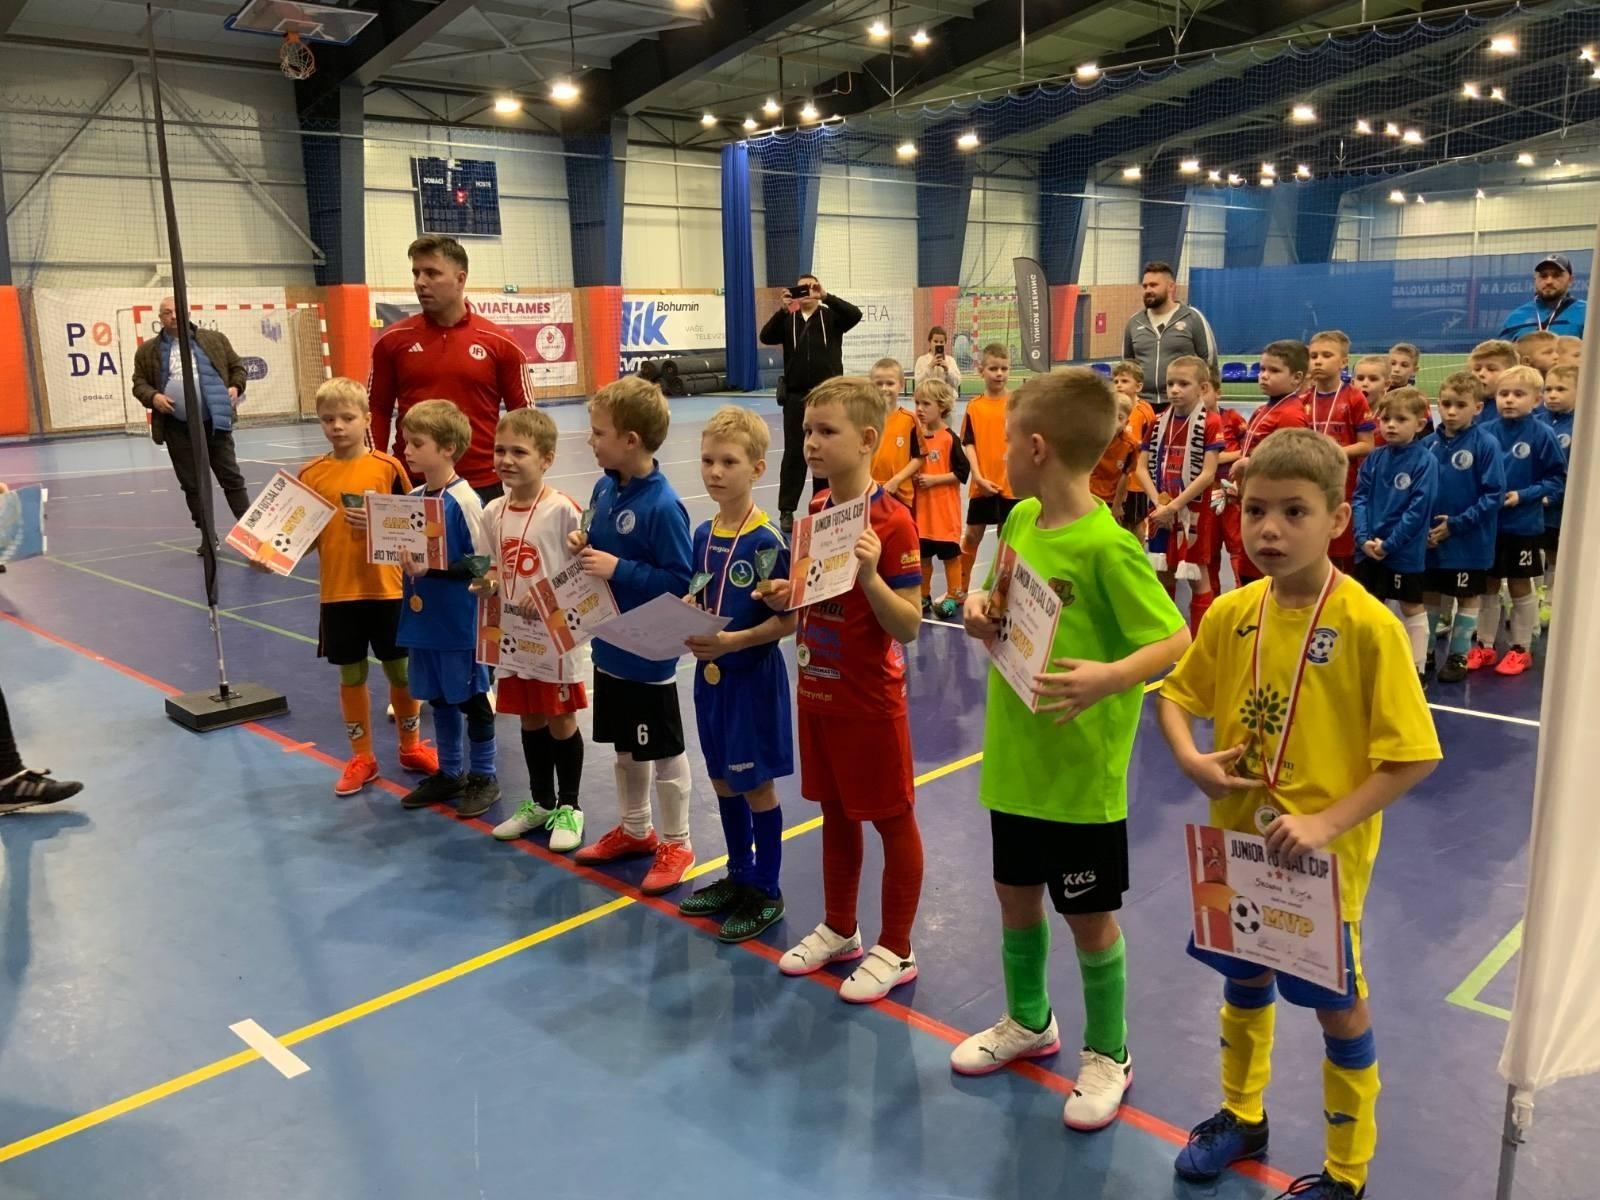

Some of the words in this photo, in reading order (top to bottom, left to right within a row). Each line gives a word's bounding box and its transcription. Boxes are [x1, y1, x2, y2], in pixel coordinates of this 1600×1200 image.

[477, 302, 551, 314] VIAFLAMES
[82, 394, 113, 402] poda.cz
[257, 489, 279, 512] FUTSAL
[272, 477, 287, 491] CUP
[281, 505, 306, 536] MVP
[813, 514, 831, 534] JUNIOR
[832, 506, 852, 527] FUTSAL
[852, 502, 864, 519] CUP
[823, 551, 850, 574] MVP
[1518, 550, 1533, 566] 23
[1393, 574, 1402, 589] 5
[1456, 572, 1469, 588] 12
[1045, 597, 1057, 617] CUP
[518, 639, 547, 656] MVP
[636, 723, 649, 746] 6
[1230, 839, 1265, 863] JUNIOR
[1308, 856, 1329, 879] CUP
[1062, 870, 1097, 886] KKS
[1261, 905, 1315, 938] MVP
